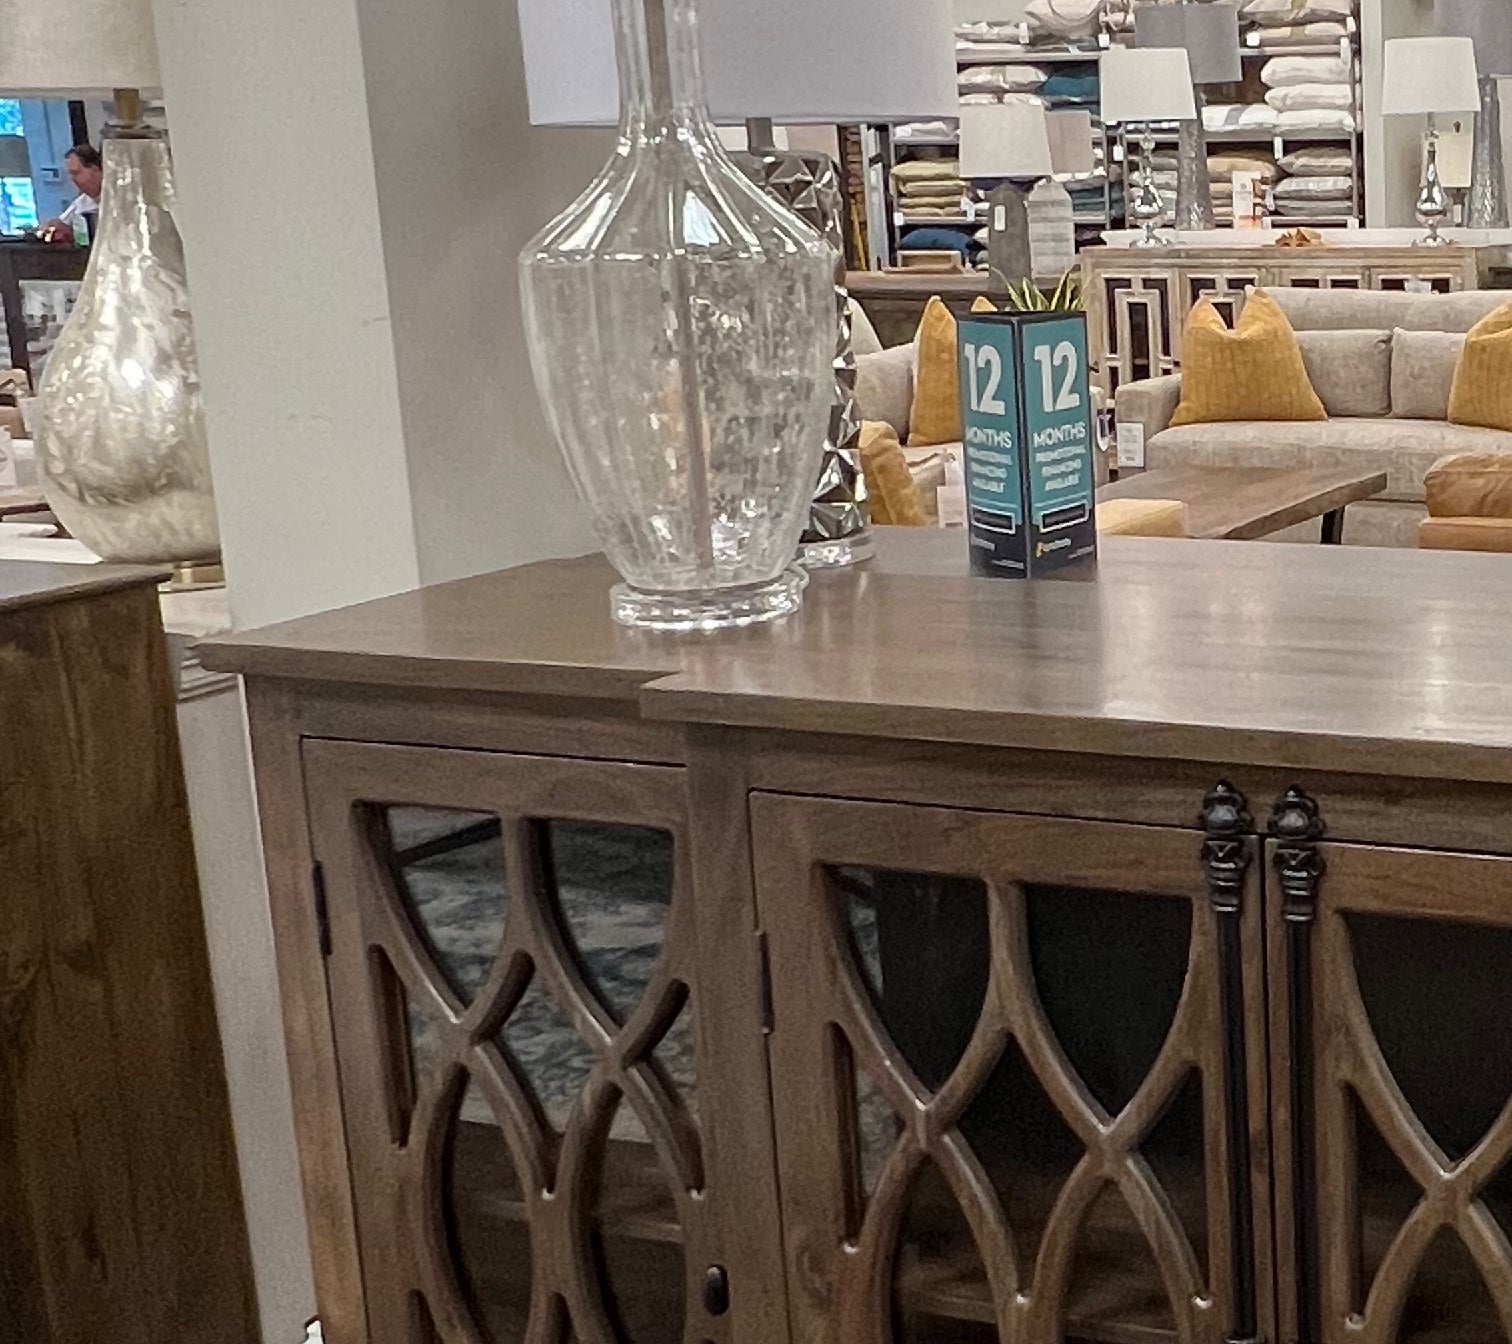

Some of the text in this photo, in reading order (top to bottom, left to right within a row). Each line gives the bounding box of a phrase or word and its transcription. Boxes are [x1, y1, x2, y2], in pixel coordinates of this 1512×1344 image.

[963, 342, 1006, 416] 12
[1033, 340, 1081, 413] 12
[1032, 420, 1086, 449] MONTHS
